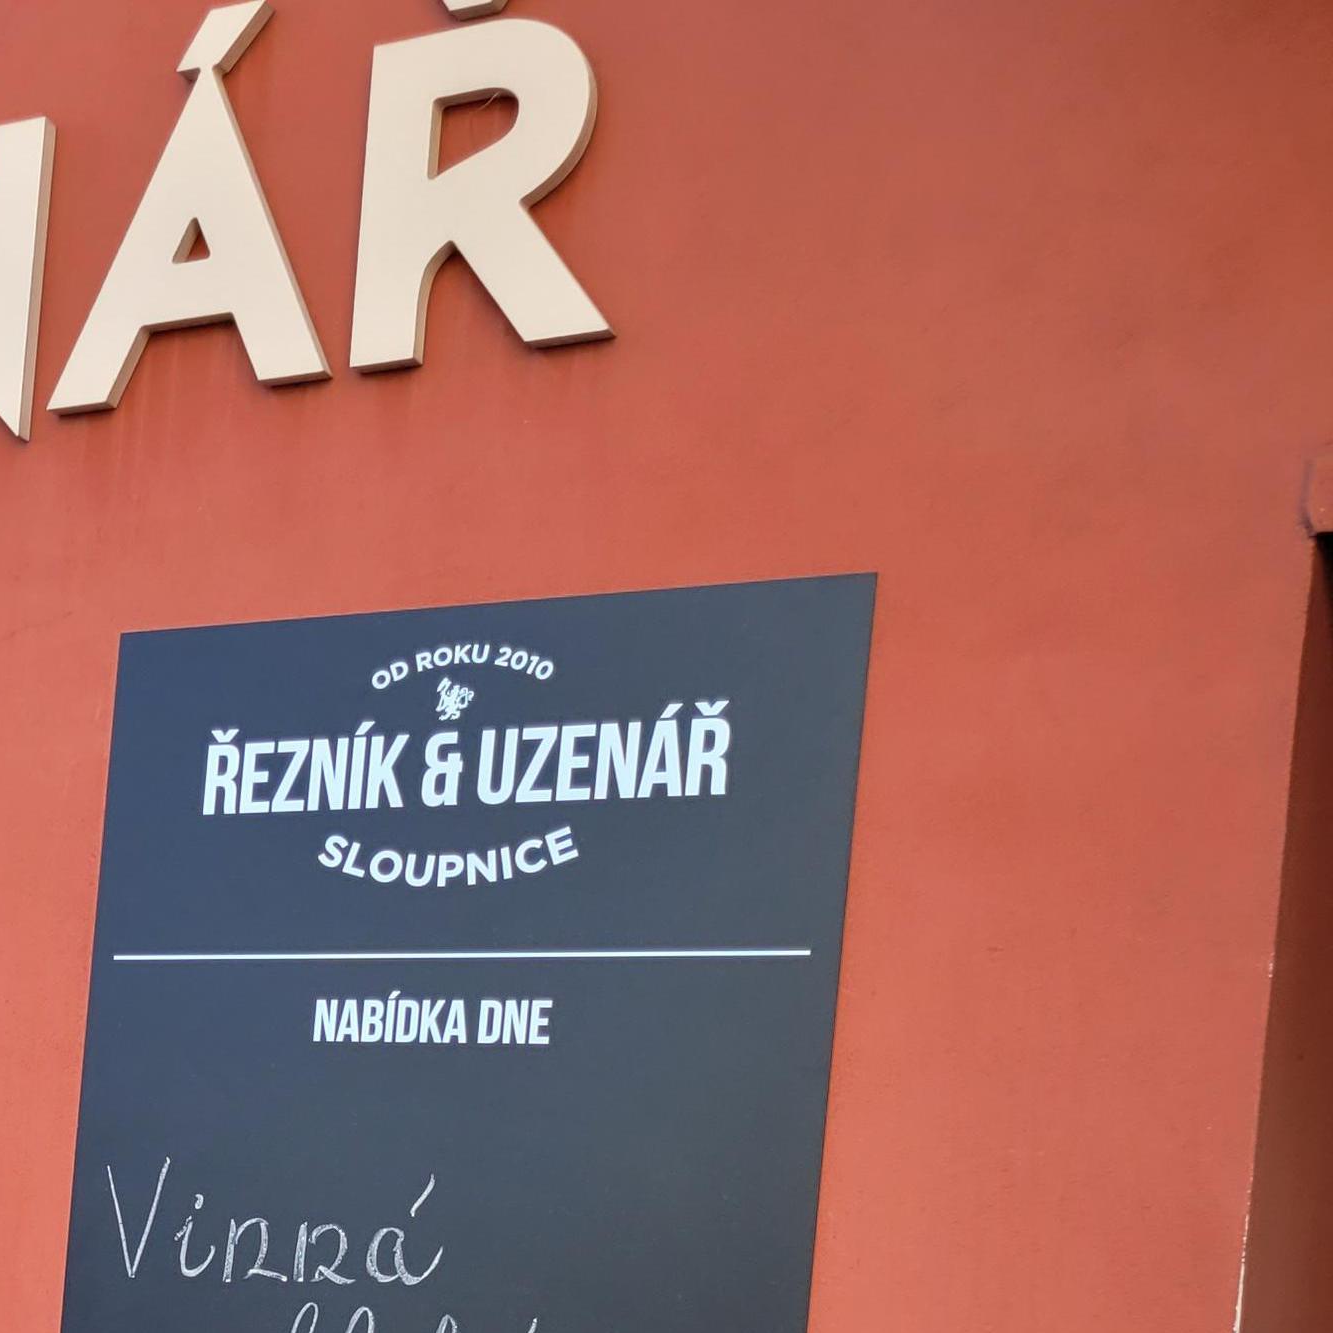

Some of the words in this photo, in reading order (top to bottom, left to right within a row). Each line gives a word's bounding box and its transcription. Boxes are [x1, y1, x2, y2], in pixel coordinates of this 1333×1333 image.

[371, 660, 410, 690] OD
[415, 643, 491, 672] ROKU
[494, 646, 555, 682] 2010
[202, 720, 406, 816] ŘEZNÍK
[421, 730, 464, 808] &
[476, 699, 731, 805] UZENÁŘ
[317, 825, 580, 888] SLOUPNICE
[312, 990, 467, 1044] NABÍDKA
[476, 998, 553, 1045] DNE
[106, 1157, 443, 1286] Vinná
